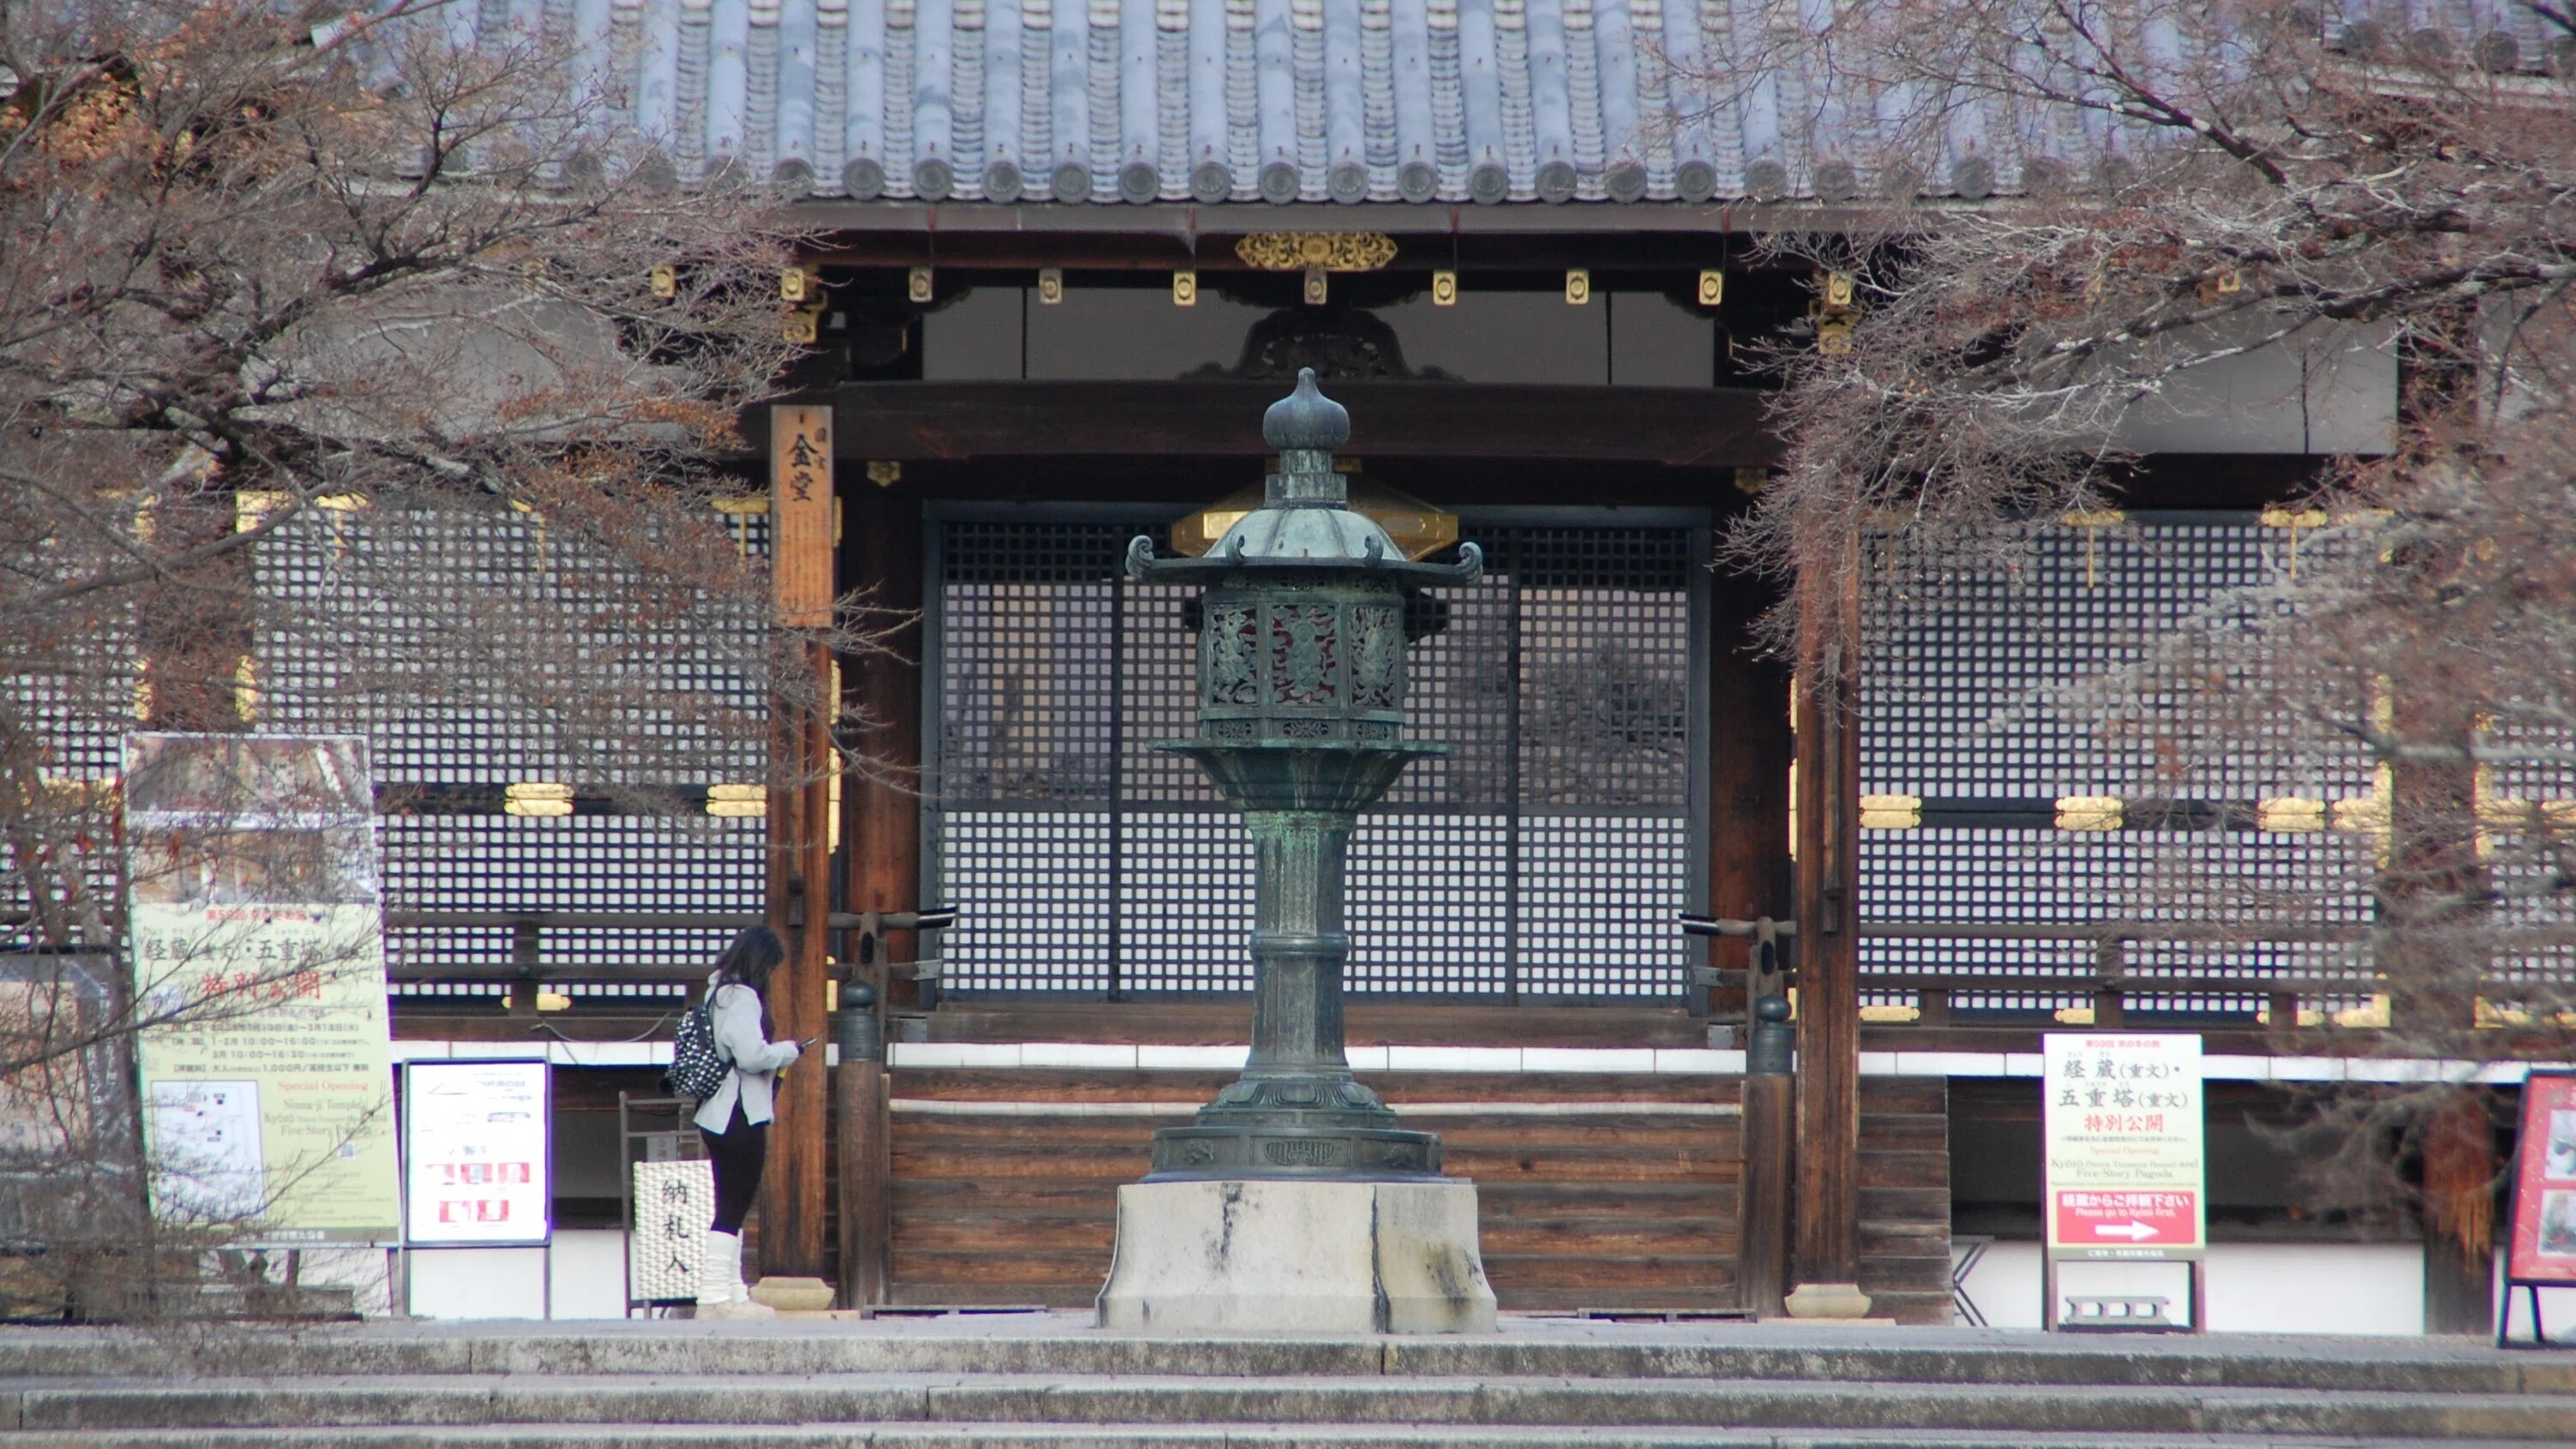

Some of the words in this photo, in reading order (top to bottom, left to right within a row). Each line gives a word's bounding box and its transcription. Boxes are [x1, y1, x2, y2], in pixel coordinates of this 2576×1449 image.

[786, 433, 819, 503] 金堂
[277, 1081, 319, 1093] Special
[321, 1081, 369, 1093] Opening
[2084, 1113, 2165, 1133] 特別公開
[2090, 1146, 2121, 1155] Special
[2123, 1146, 2161, 1155] Opening
[2179, 1159, 2198, 1168] and
[2135, 1168, 2174, 1180] Pagoda
[2075, 1208, 2104, 1217] Please
[2105, 1209, 2117, 1219] go
[2118, 1208, 2129, 1217] to
